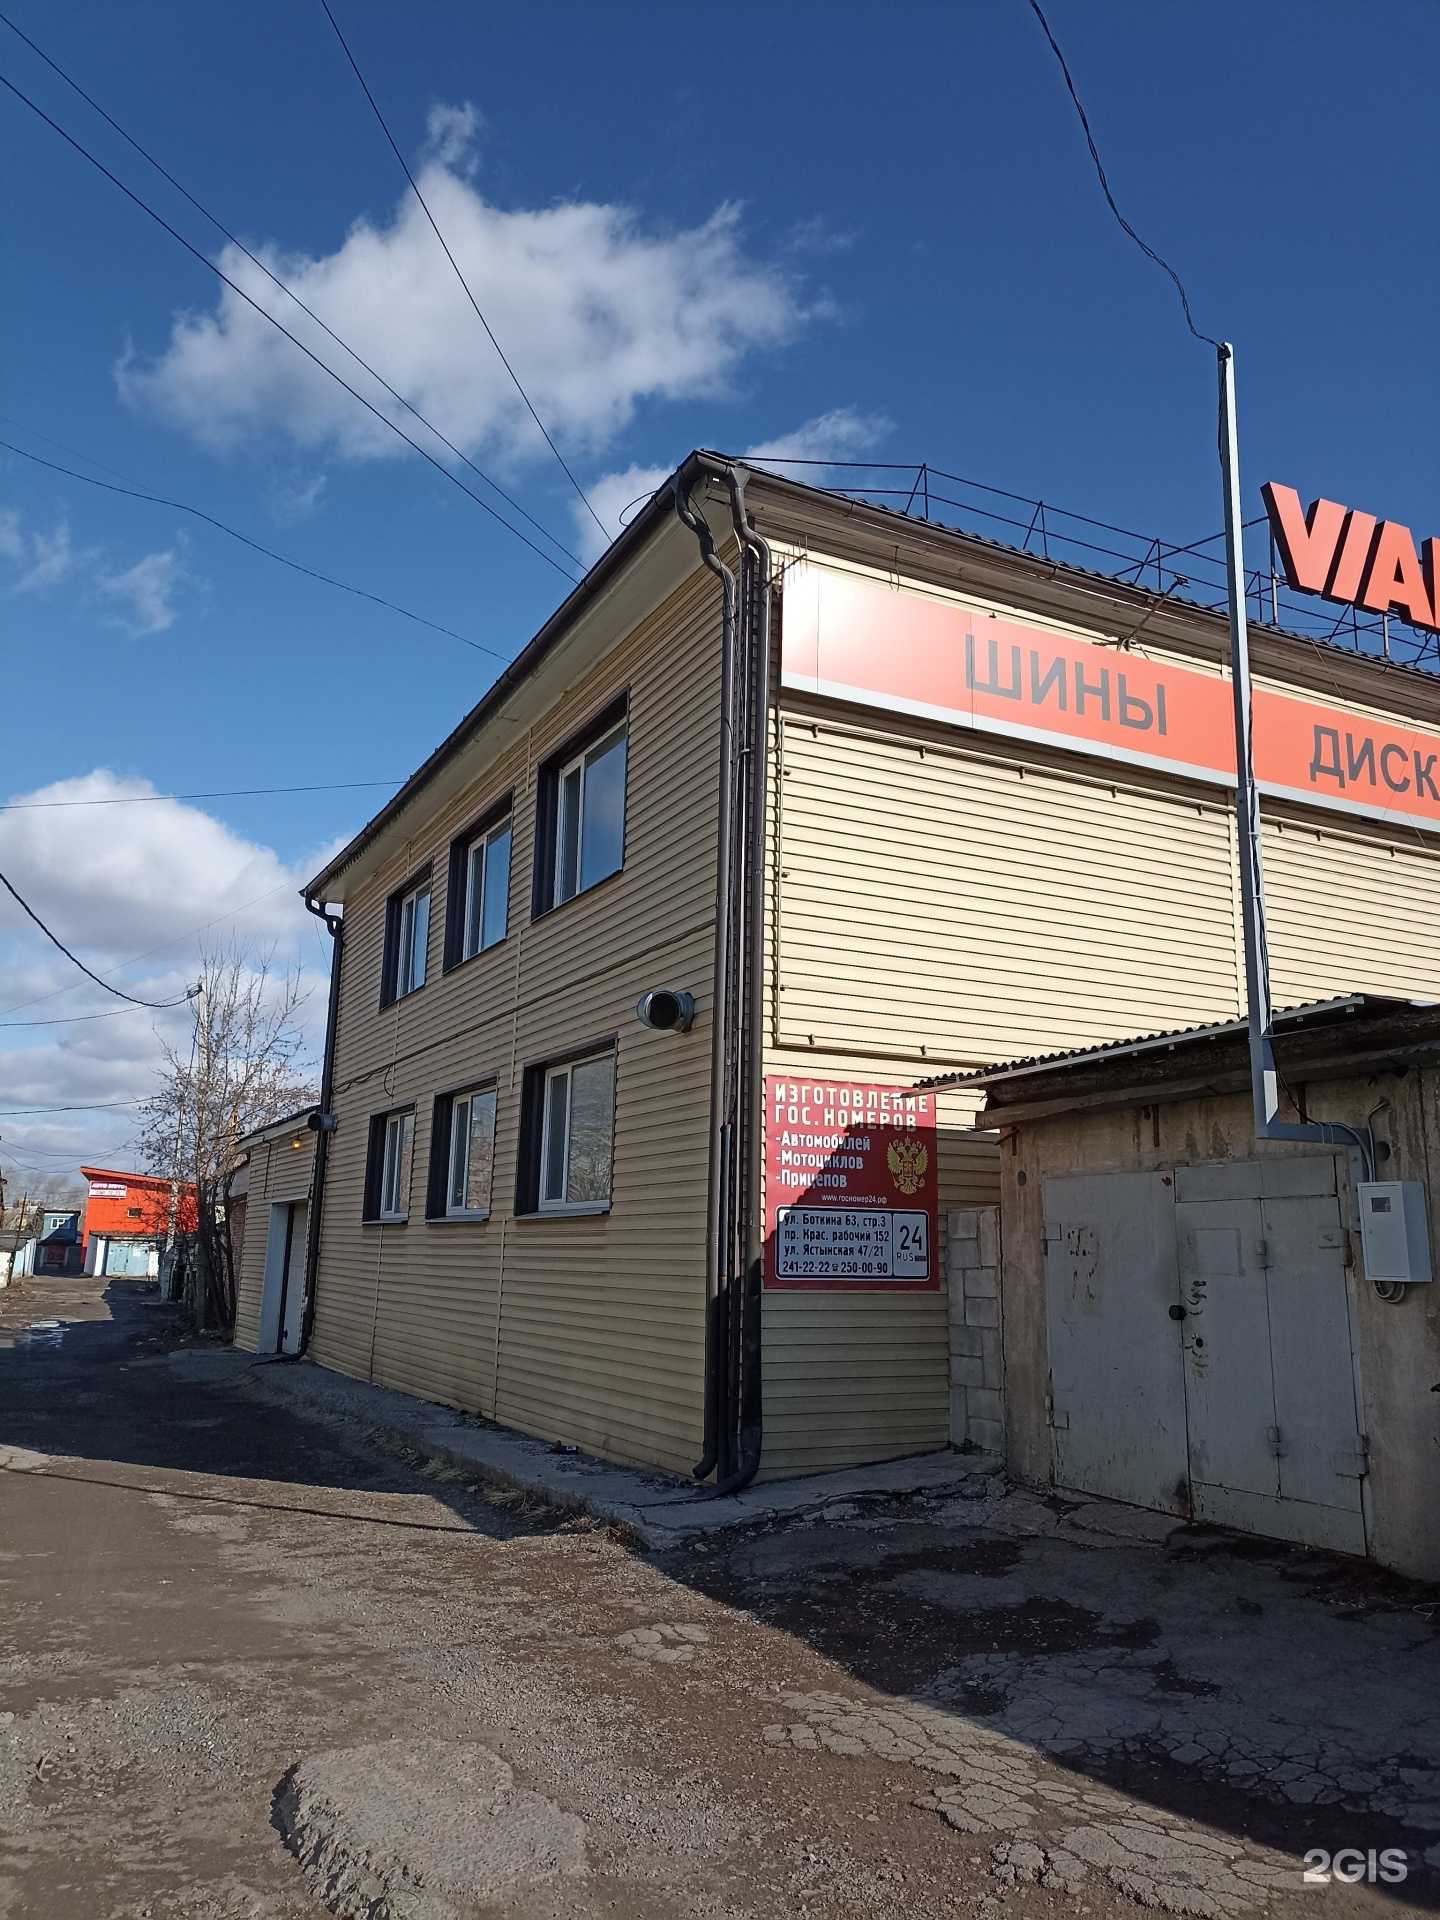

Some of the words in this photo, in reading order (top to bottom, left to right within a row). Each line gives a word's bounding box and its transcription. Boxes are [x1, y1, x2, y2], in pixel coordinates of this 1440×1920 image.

[1260, 481, 1440, 632] VIA
[964, 633, 1168, 736] ШИНЫ
[775, 1105, 819, 1125] ГОС.
[824, 1108, 917, 1132] НОМЕРОВ
[784, 1215, 799, 1226] ул.
[802, 1214, 842, 1226] Боткина
[784, 1230, 799, 1241] пр.
[803, 1229, 829, 1241] Крас.
[832, 1230, 871, 1242] рабочий
[874, 1230, 889, 1242] 152
[900, 1225, 922, 1251] 24
[784, 1245, 799, 1257] ул.
[803, 1244, 855, 1256] Ястынская
[858, 1245, 884, 1257] 47/21
[896, 1252, 914, 1262] RUS
[783, 1261, 830, 1273] 241-22-22
[841, 1262, 888, 1274] 250-00-90
